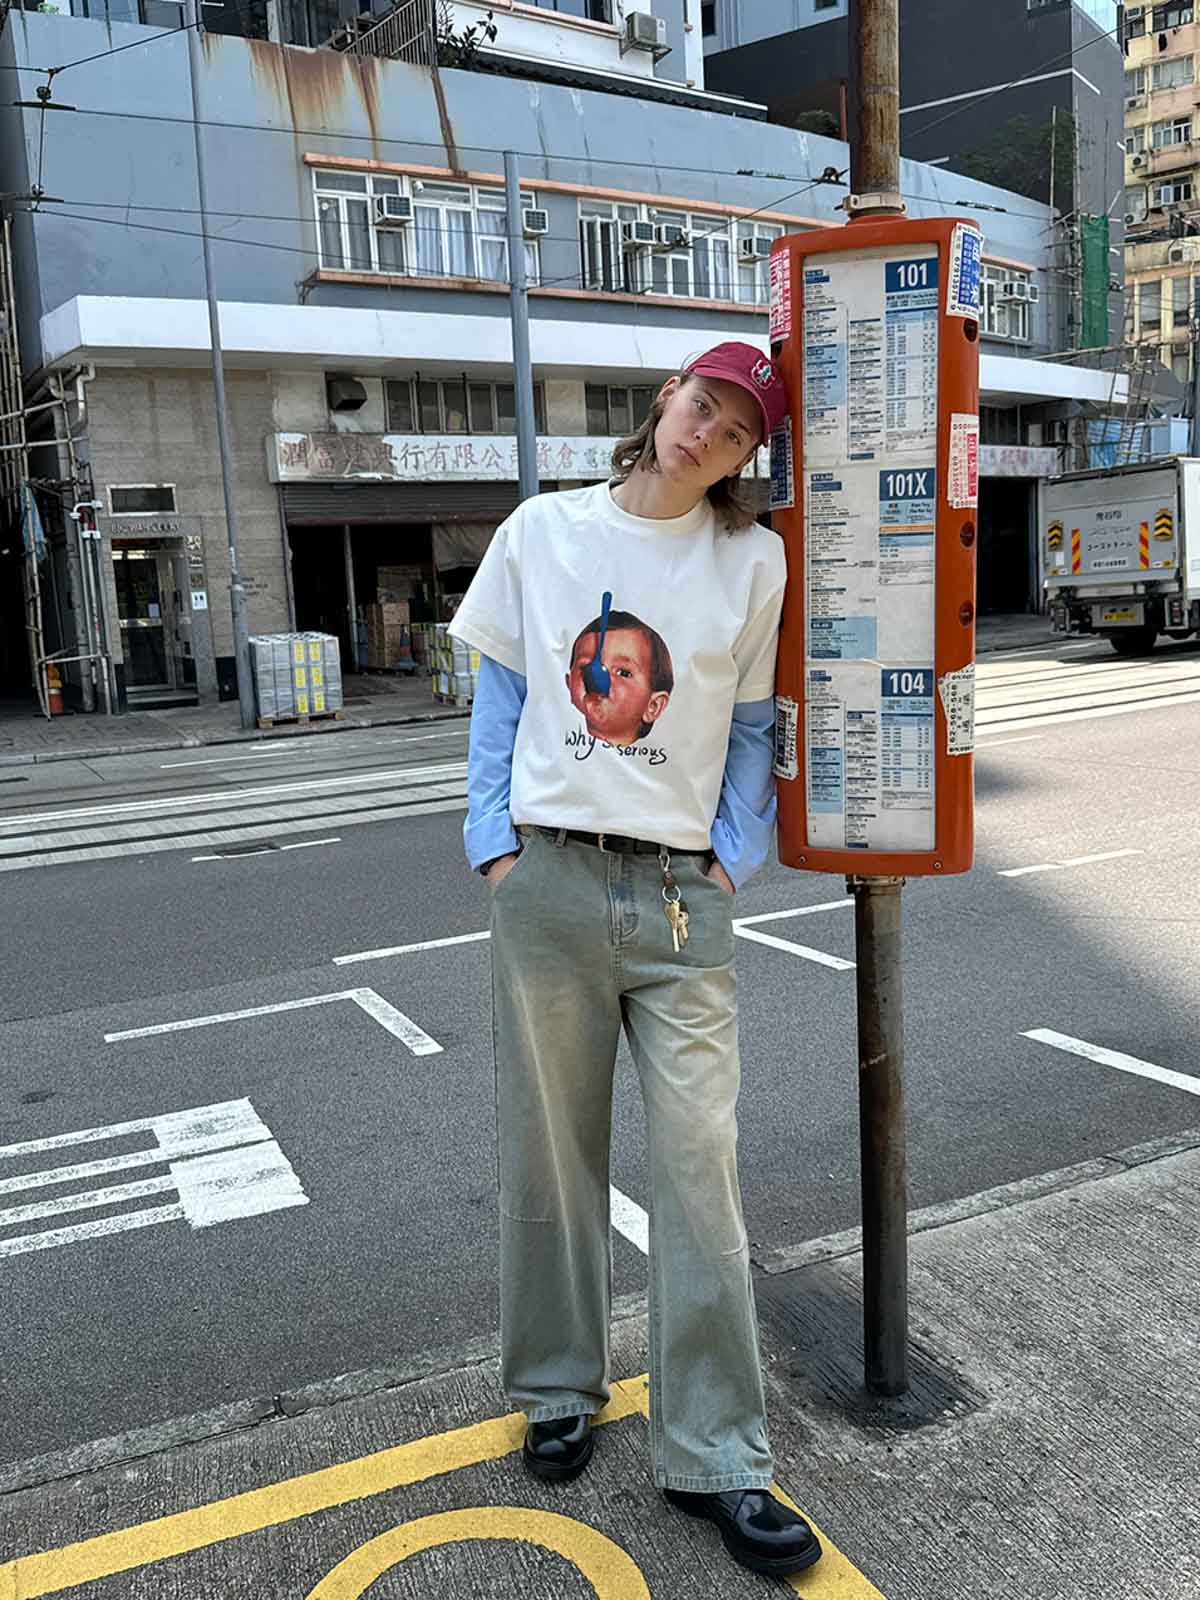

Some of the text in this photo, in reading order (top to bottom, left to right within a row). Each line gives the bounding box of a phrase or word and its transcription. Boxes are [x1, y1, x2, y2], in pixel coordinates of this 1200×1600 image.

[896, 262, 928, 288] 101
[887, 471, 928, 497] 101X
[889, 671, 925, 694] 104
[616, 743, 668, 766] serious
